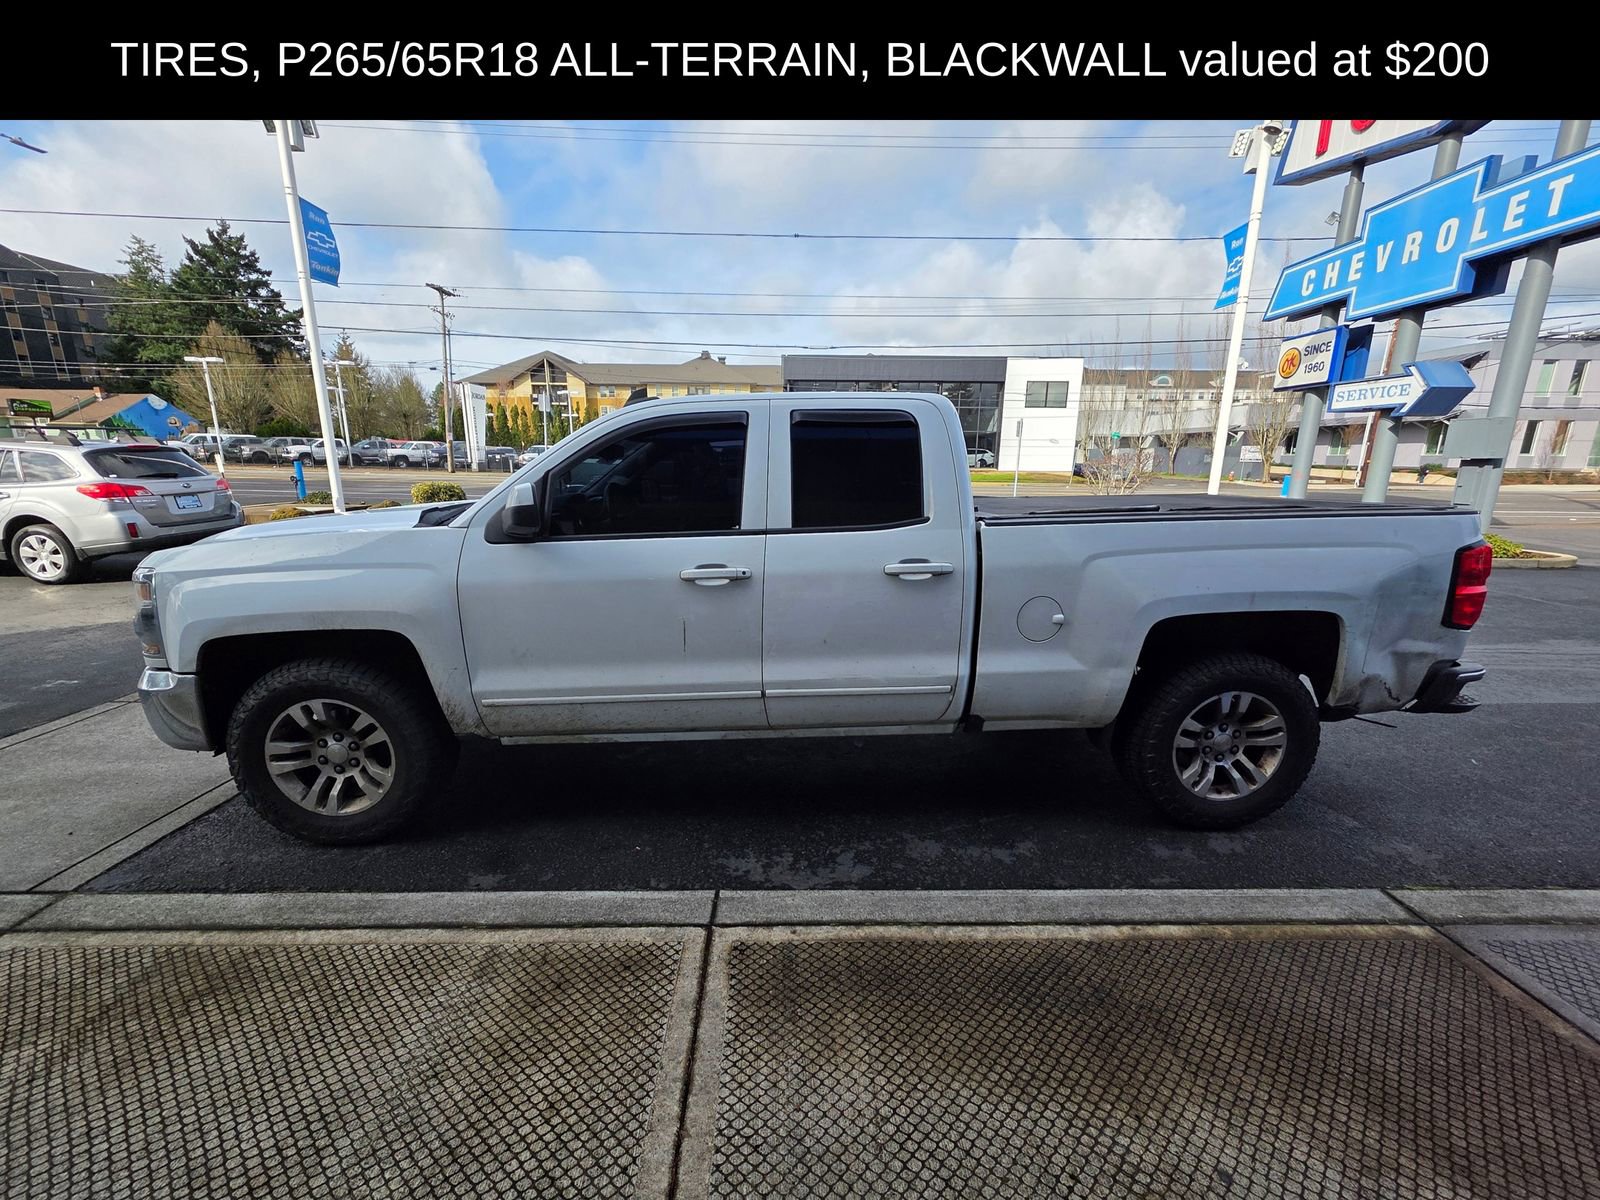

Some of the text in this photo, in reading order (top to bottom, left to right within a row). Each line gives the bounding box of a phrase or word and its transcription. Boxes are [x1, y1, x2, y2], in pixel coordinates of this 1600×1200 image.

[1301, 174, 1574, 297] CHEVROLET
[1303, 340, 1333, 357] SINCE
[1281, 352, 1297, 374] OK
[1303, 361, 1325, 374] 1960
[1335, 383, 1412, 403] SERVICE
